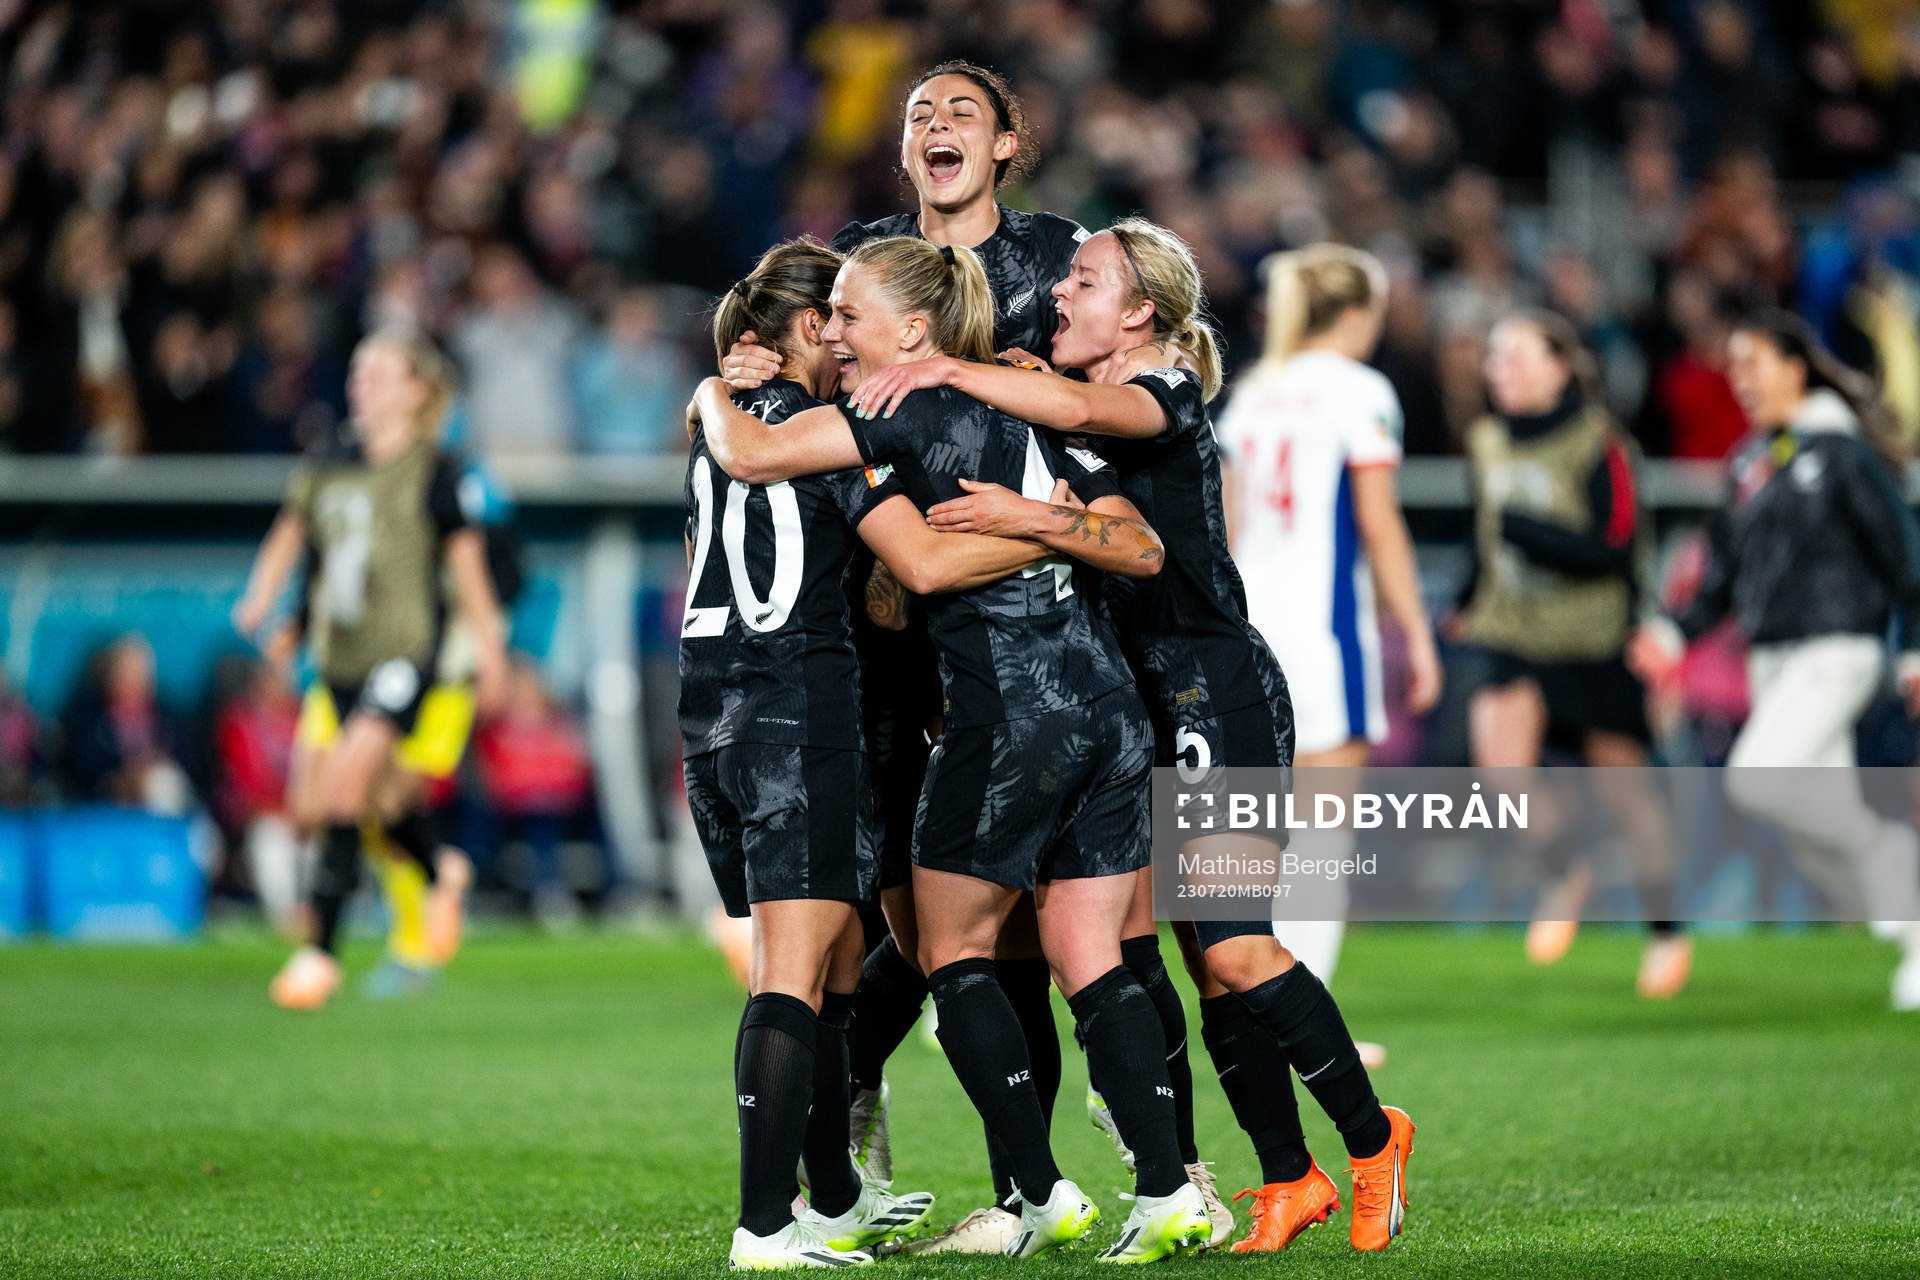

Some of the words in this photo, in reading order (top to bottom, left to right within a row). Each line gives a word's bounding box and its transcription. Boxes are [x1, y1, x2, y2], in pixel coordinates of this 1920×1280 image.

[680, 455, 805, 638] 20
[1006, 1069, 1030, 1087] NZ
[1155, 1085, 1175, 1099] NZ
[738, 1094, 756, 1107] NZ
